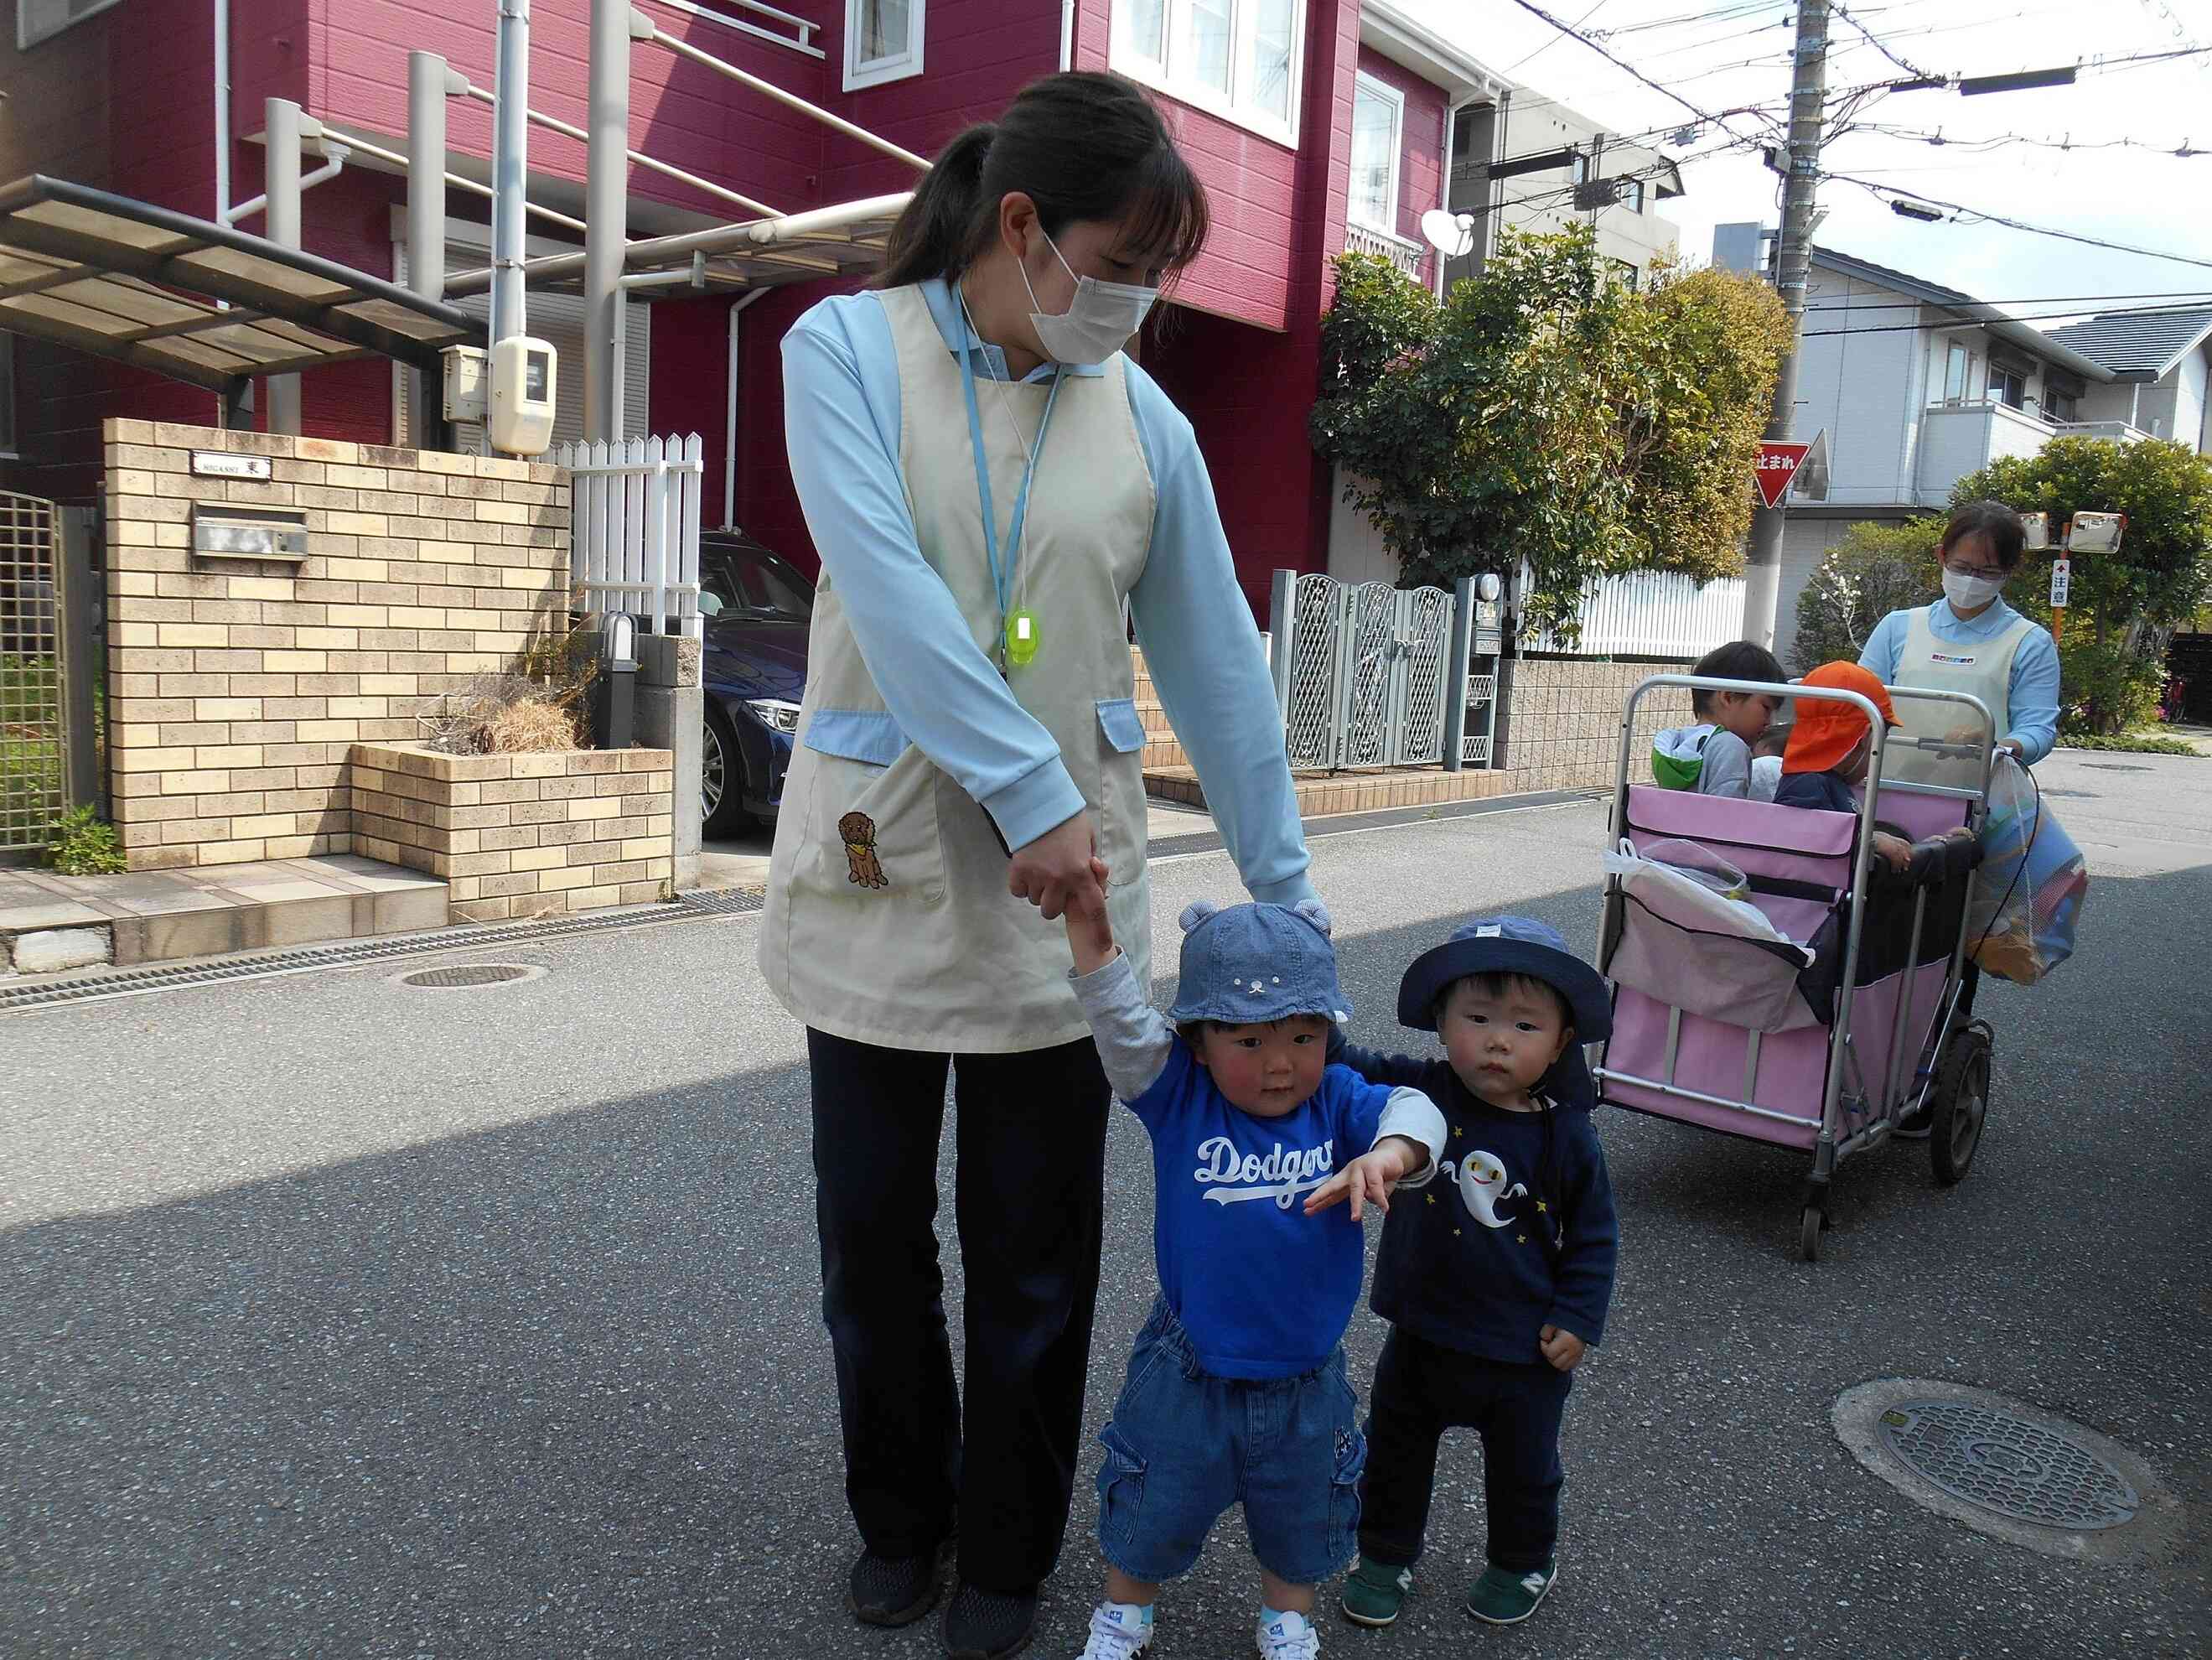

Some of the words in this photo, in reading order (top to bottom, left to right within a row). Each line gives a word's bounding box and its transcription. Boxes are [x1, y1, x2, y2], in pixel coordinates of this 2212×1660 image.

[246, 461, 259, 475] 東
[2053, 577, 2066, 603] 注意
[1194, 1136, 1334, 1210] Dodger
